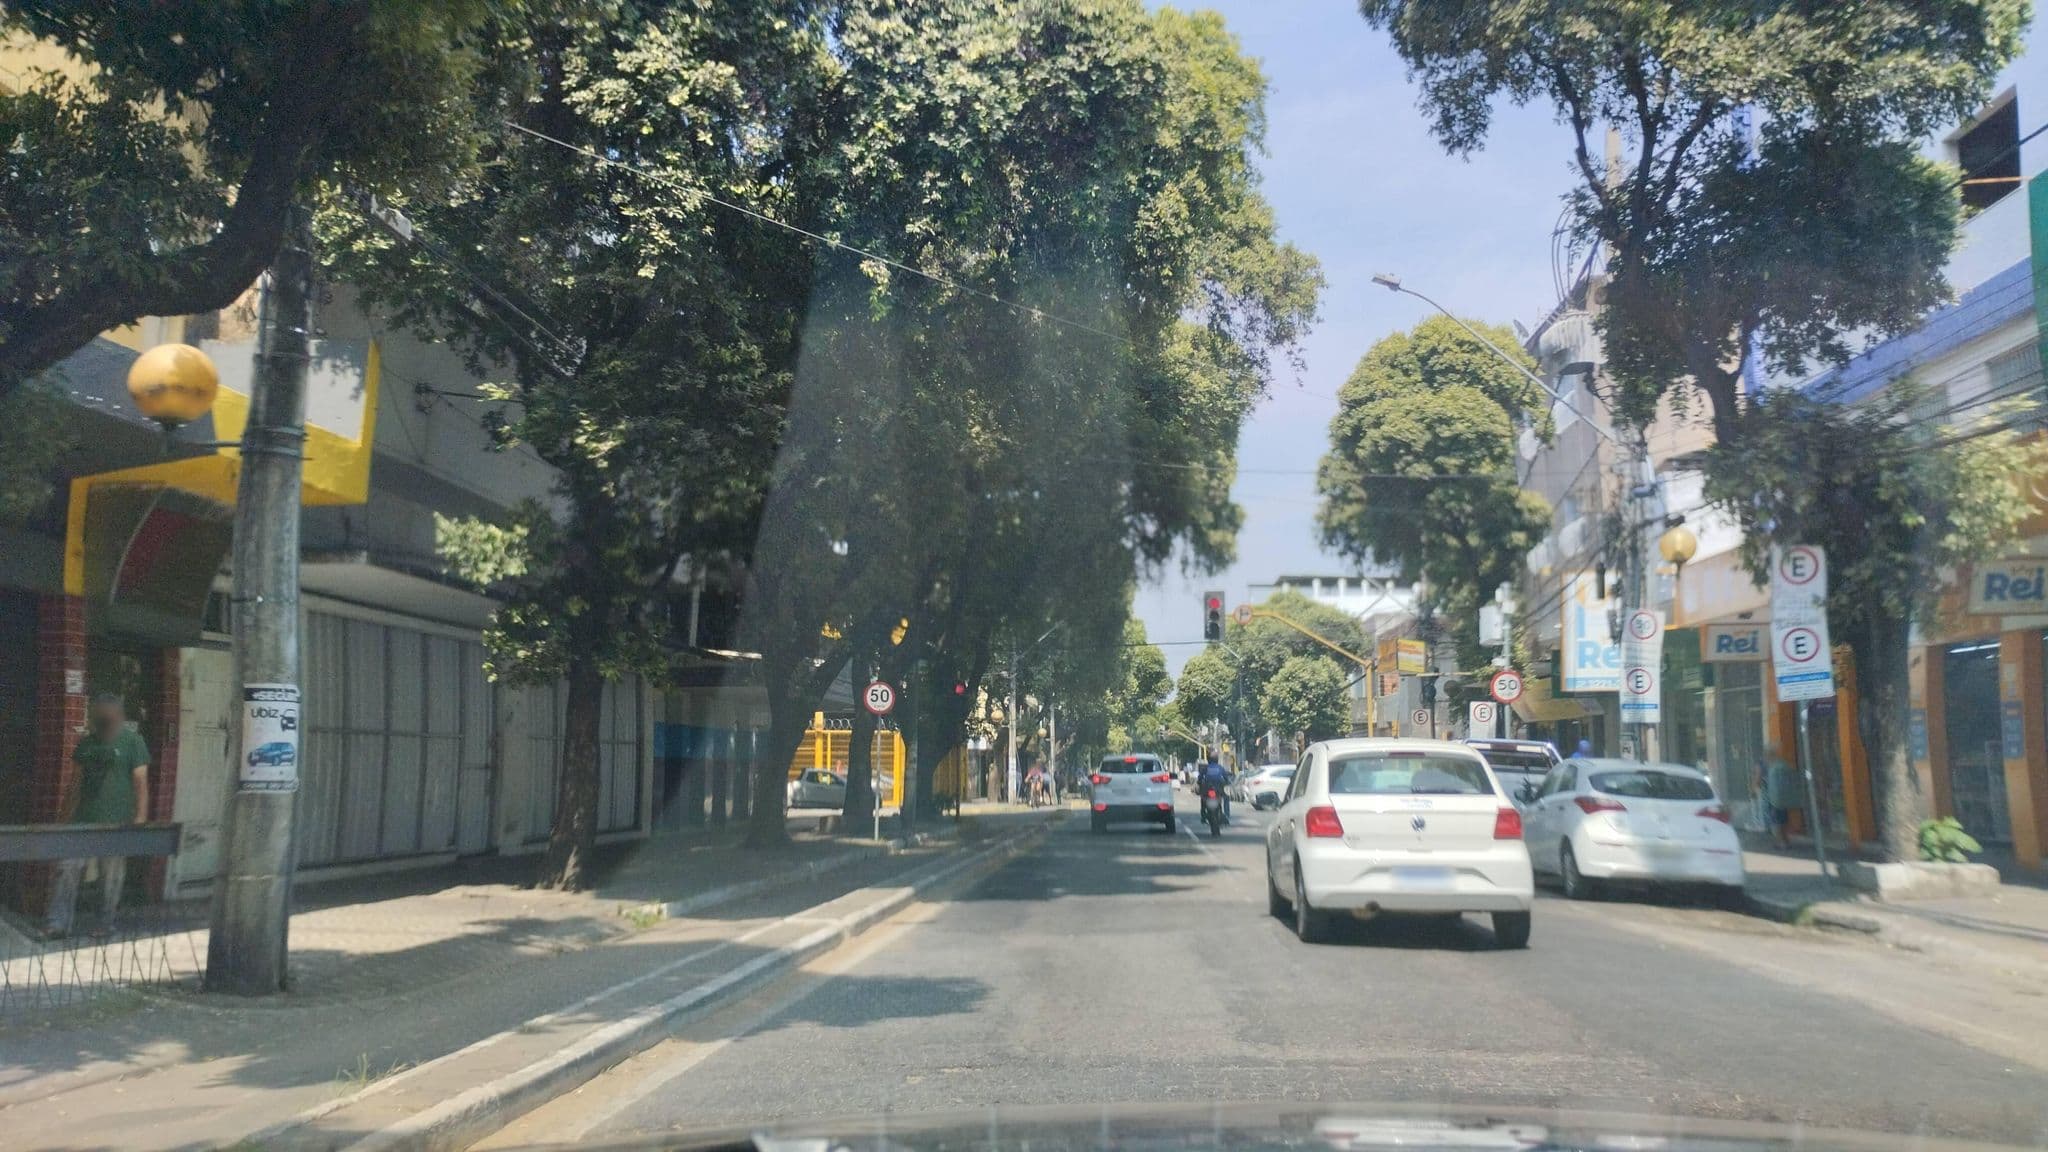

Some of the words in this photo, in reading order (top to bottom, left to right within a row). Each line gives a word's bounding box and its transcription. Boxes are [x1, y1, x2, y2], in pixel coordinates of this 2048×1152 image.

[1792, 556, 1806, 577] E
[1983, 567, 2045, 601] Rei
[1716, 630, 1759, 653] Rei
[1794, 636, 1807, 655] E
[1578, 640, 1621, 669] Re
[1498, 679, 1517, 690] 50
[1635, 674, 1644, 689] E
[870, 689, 889, 702] 50
